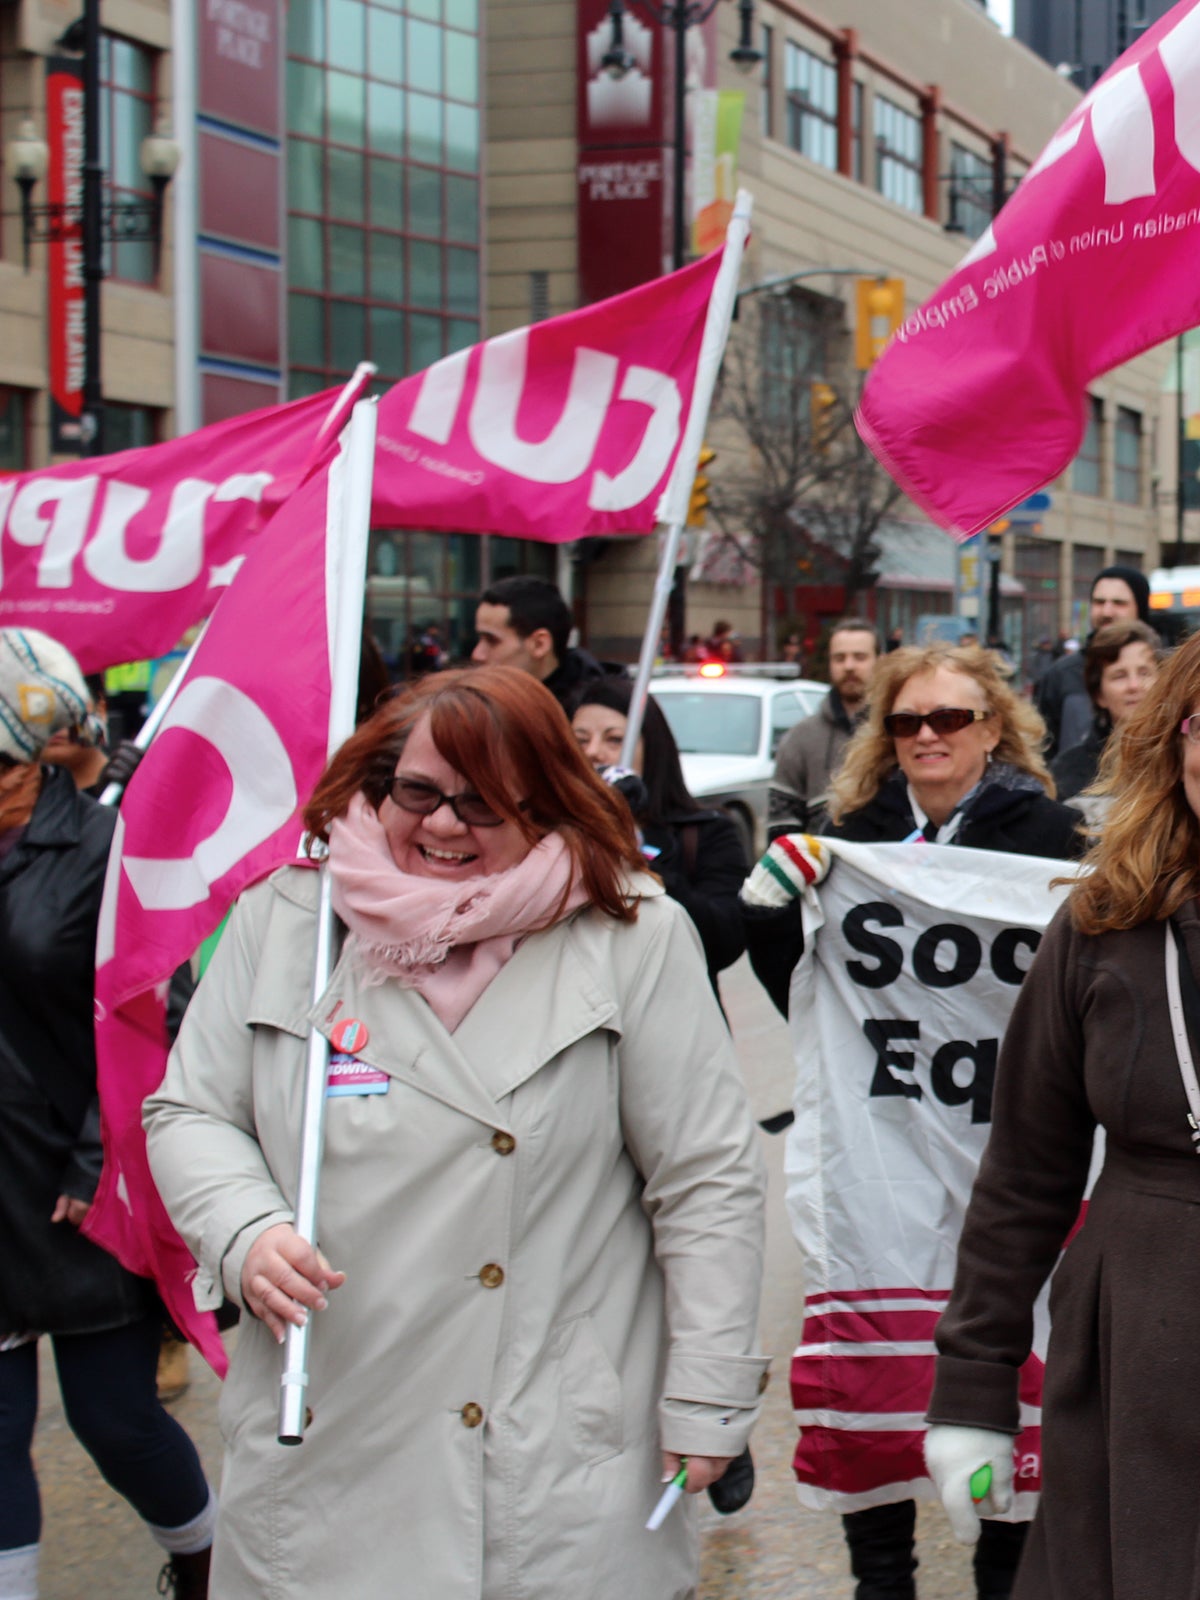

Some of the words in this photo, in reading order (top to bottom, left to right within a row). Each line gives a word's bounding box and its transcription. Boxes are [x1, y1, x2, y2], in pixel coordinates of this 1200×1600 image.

[590, 181, 649, 200] PLACE
[841, 901, 1044, 989] Soc
[862, 1018, 998, 1124] Eq
